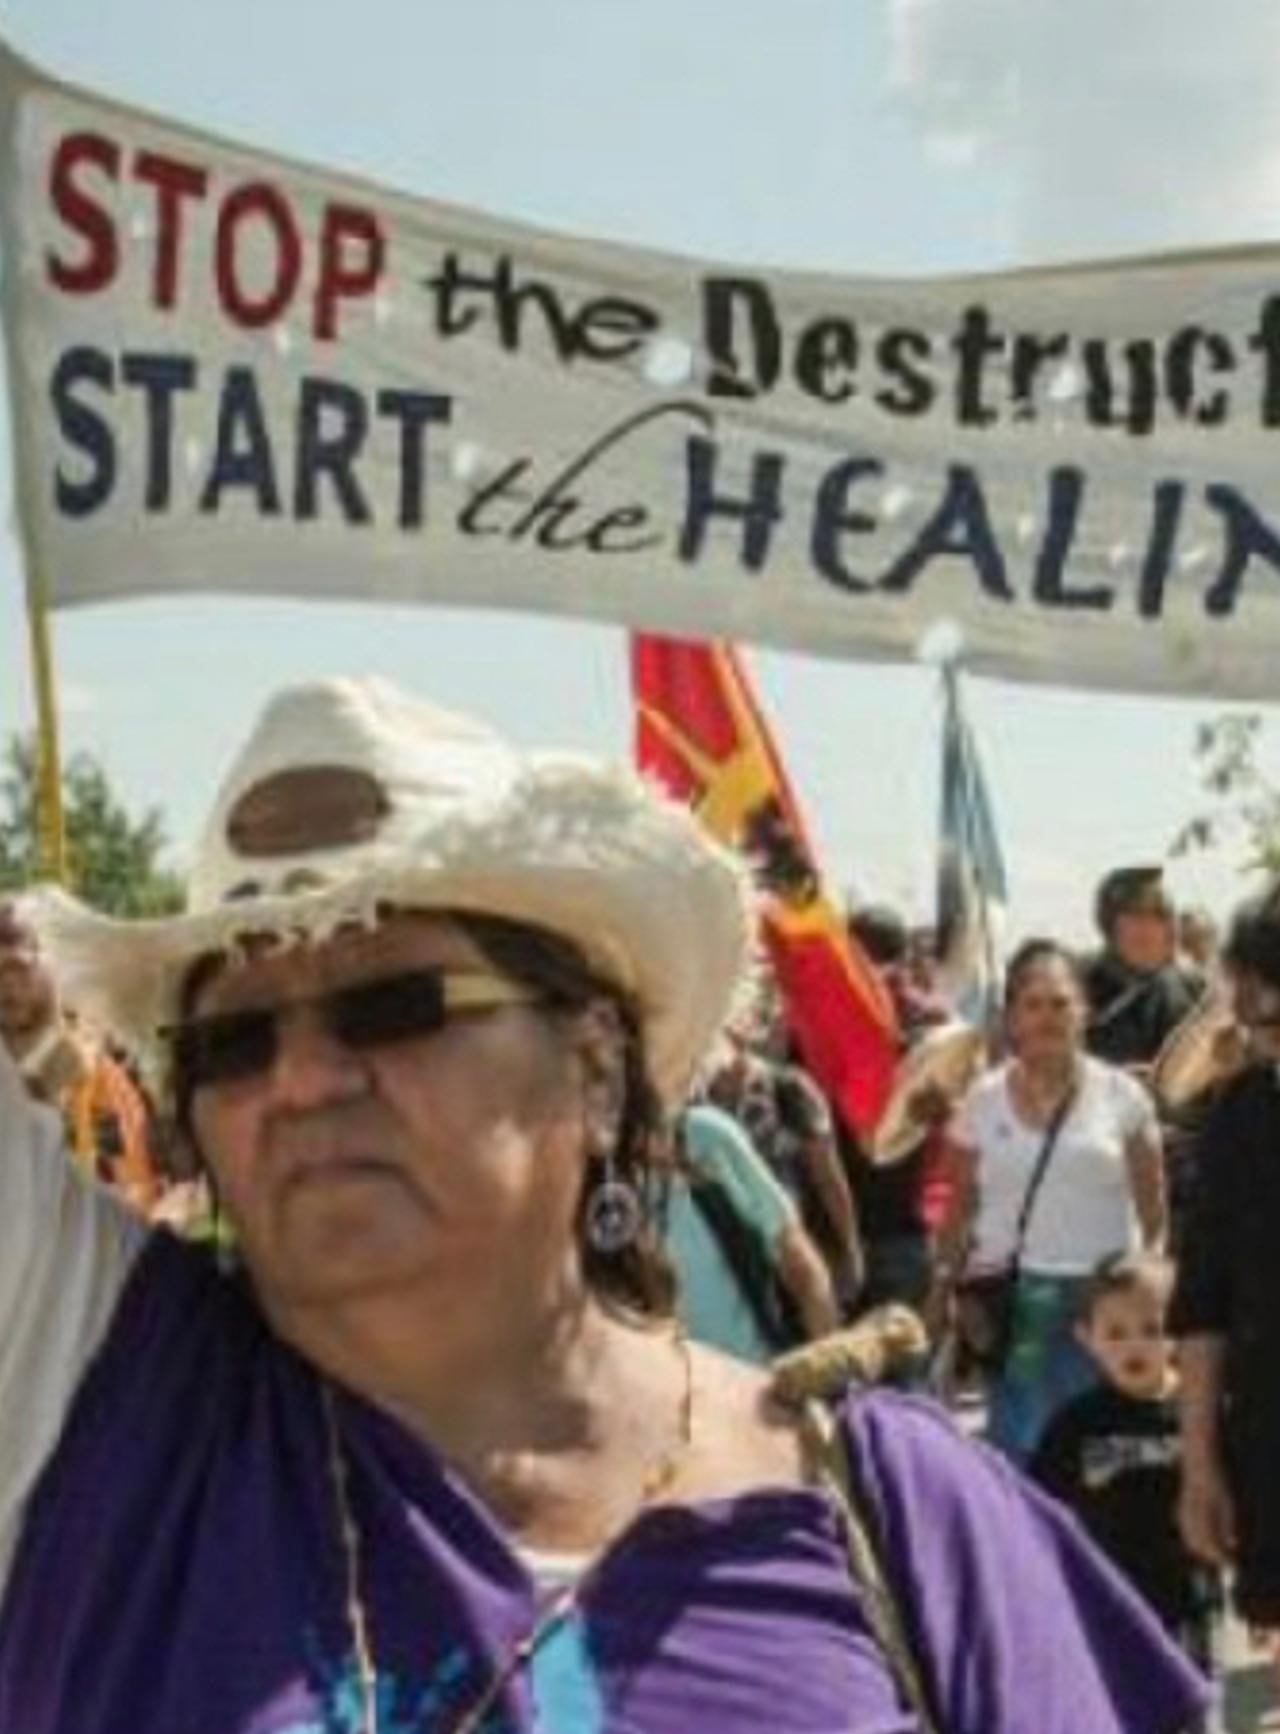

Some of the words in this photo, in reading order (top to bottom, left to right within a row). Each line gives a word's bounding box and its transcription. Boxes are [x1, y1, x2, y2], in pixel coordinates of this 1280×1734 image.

[44, 131, 388, 344] STOP
[425, 250, 660, 363] the
[48, 345, 454, 530] START
[455, 399, 712, 556] the
